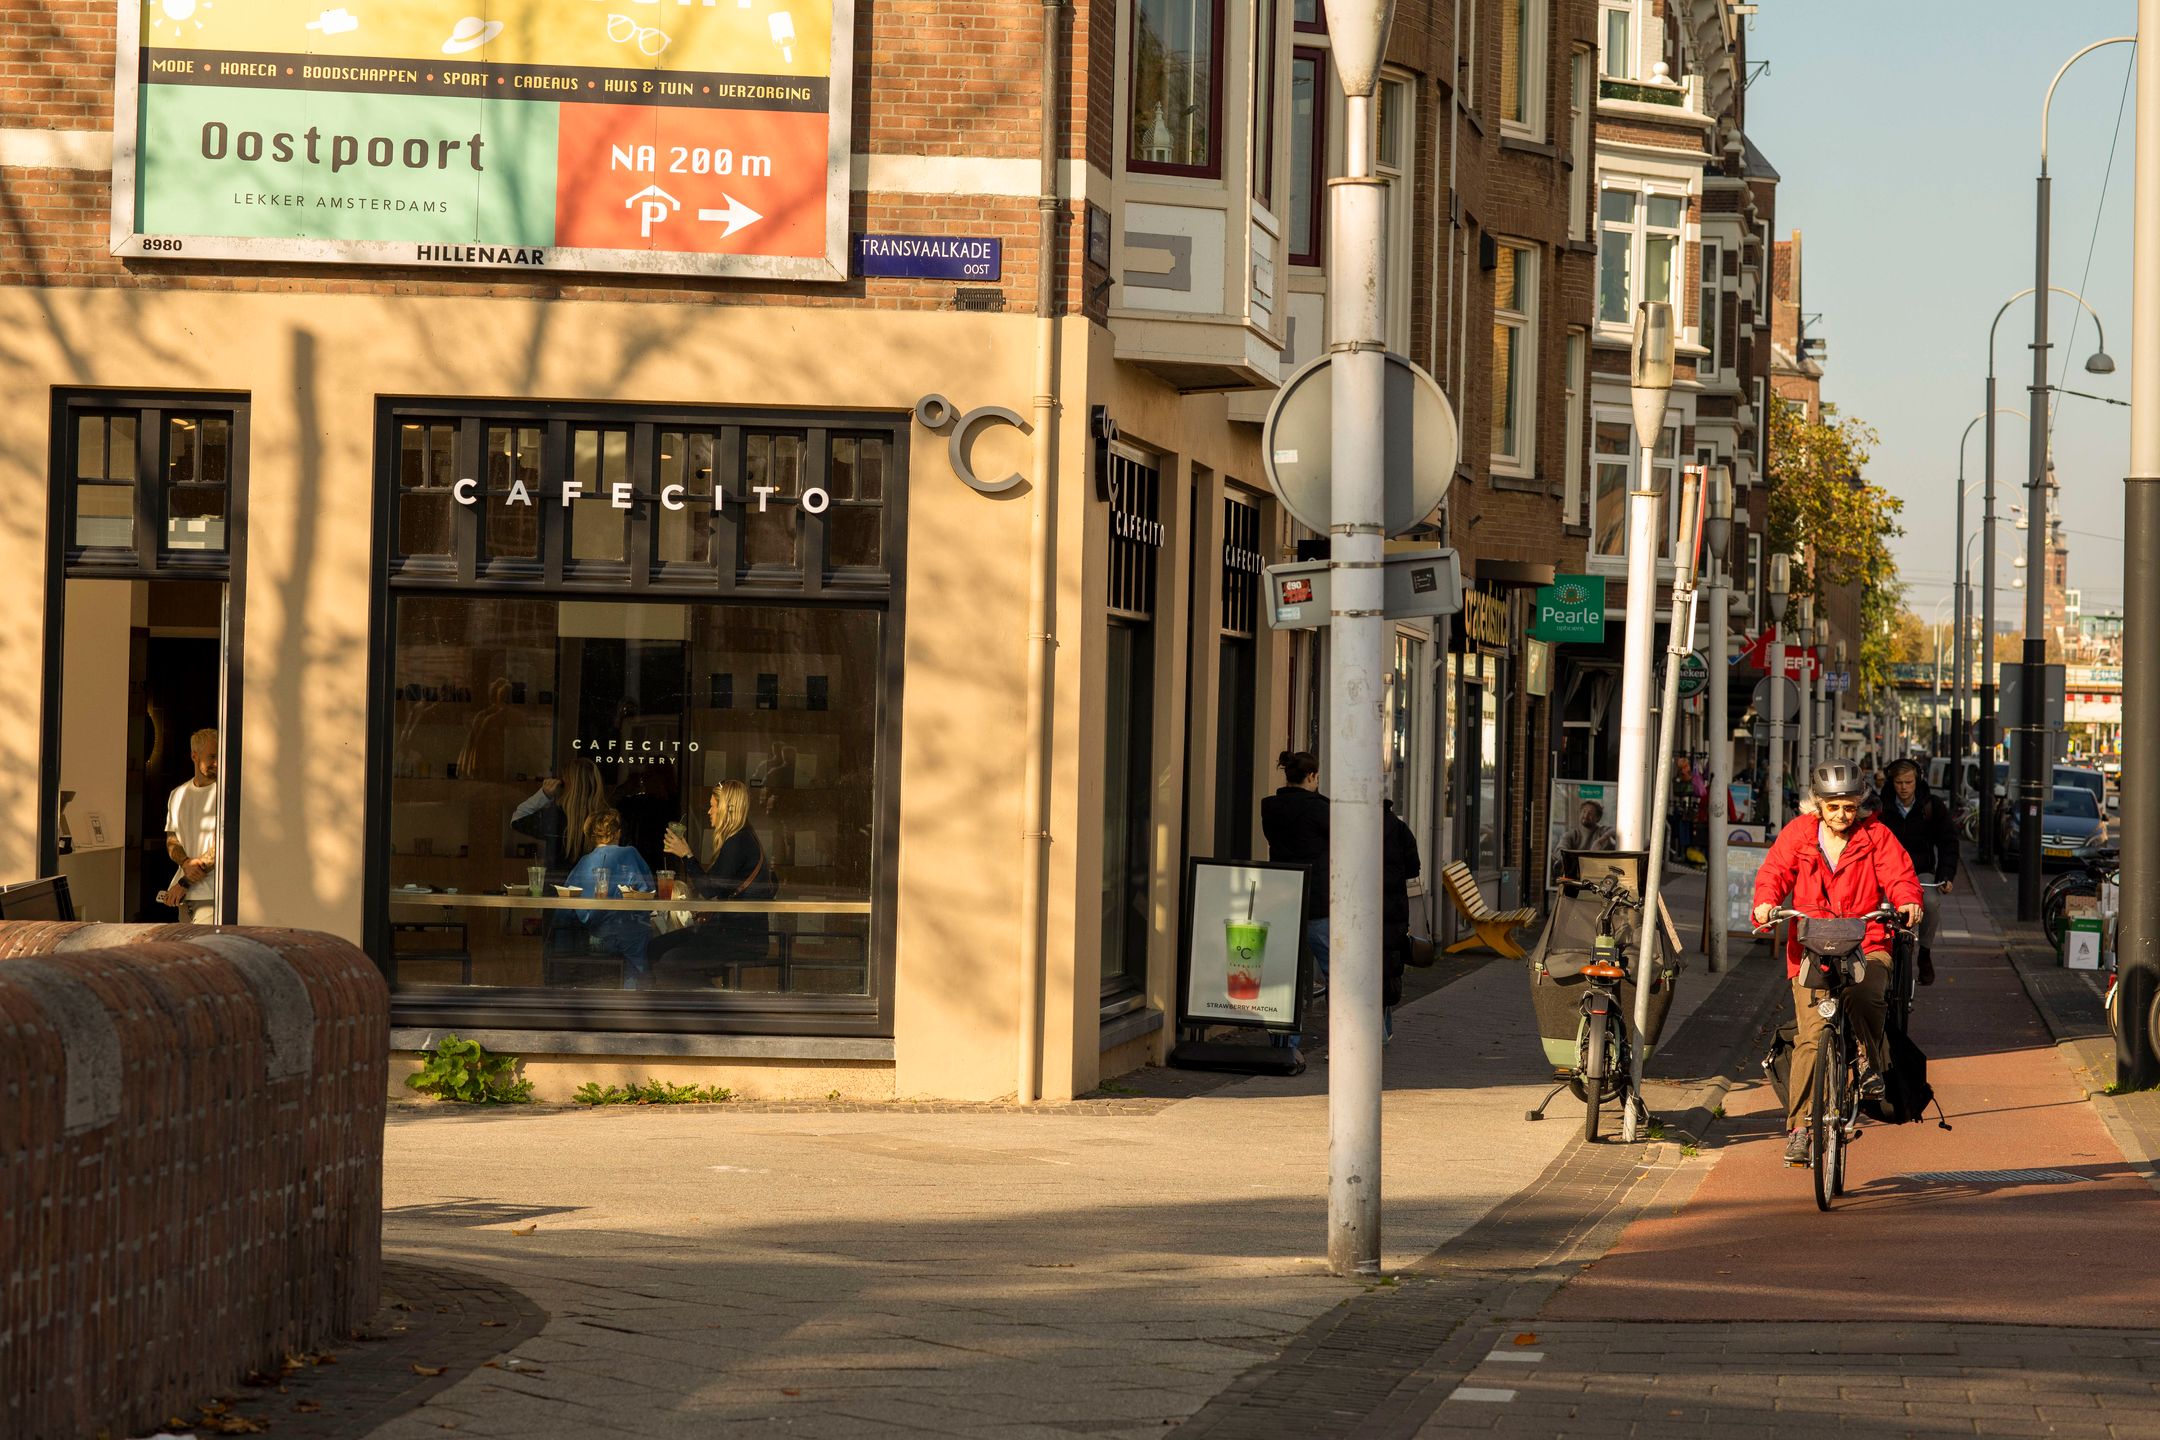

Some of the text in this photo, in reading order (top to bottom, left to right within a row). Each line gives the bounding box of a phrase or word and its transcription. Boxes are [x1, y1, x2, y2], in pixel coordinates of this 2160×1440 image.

[152, 58, 811, 102] MODE HORECA BOODSCHAPPEN SPORT CADEAUS HUIS & TUIN VERZORGING
[201, 120, 485, 173] Oostpoort
[611, 144, 771, 178] NA 200 m
[234, 192, 449, 214] LEKKER AMSTERDAMS
[641, 201, 668, 238] P
[142, 238, 182, 252] 8980
[416, 244, 544, 266] HILLENAAR
[860, 238, 991, 260] TRANSVAALKADE
[963, 263, 990, 276] OOST
[453, 478, 830, 515] CAFECITO
[1116, 510, 1165, 548] CAFECITO
[1225, 544, 1266, 576] CAFECITO
[1542, 606, 1600, 624] Pearle
[572, 739, 700, 752] CAFECITO
[595, 754, 678, 766] ROASTERY
[1206, 1002, 1250, 1010] STRAWBERRY
